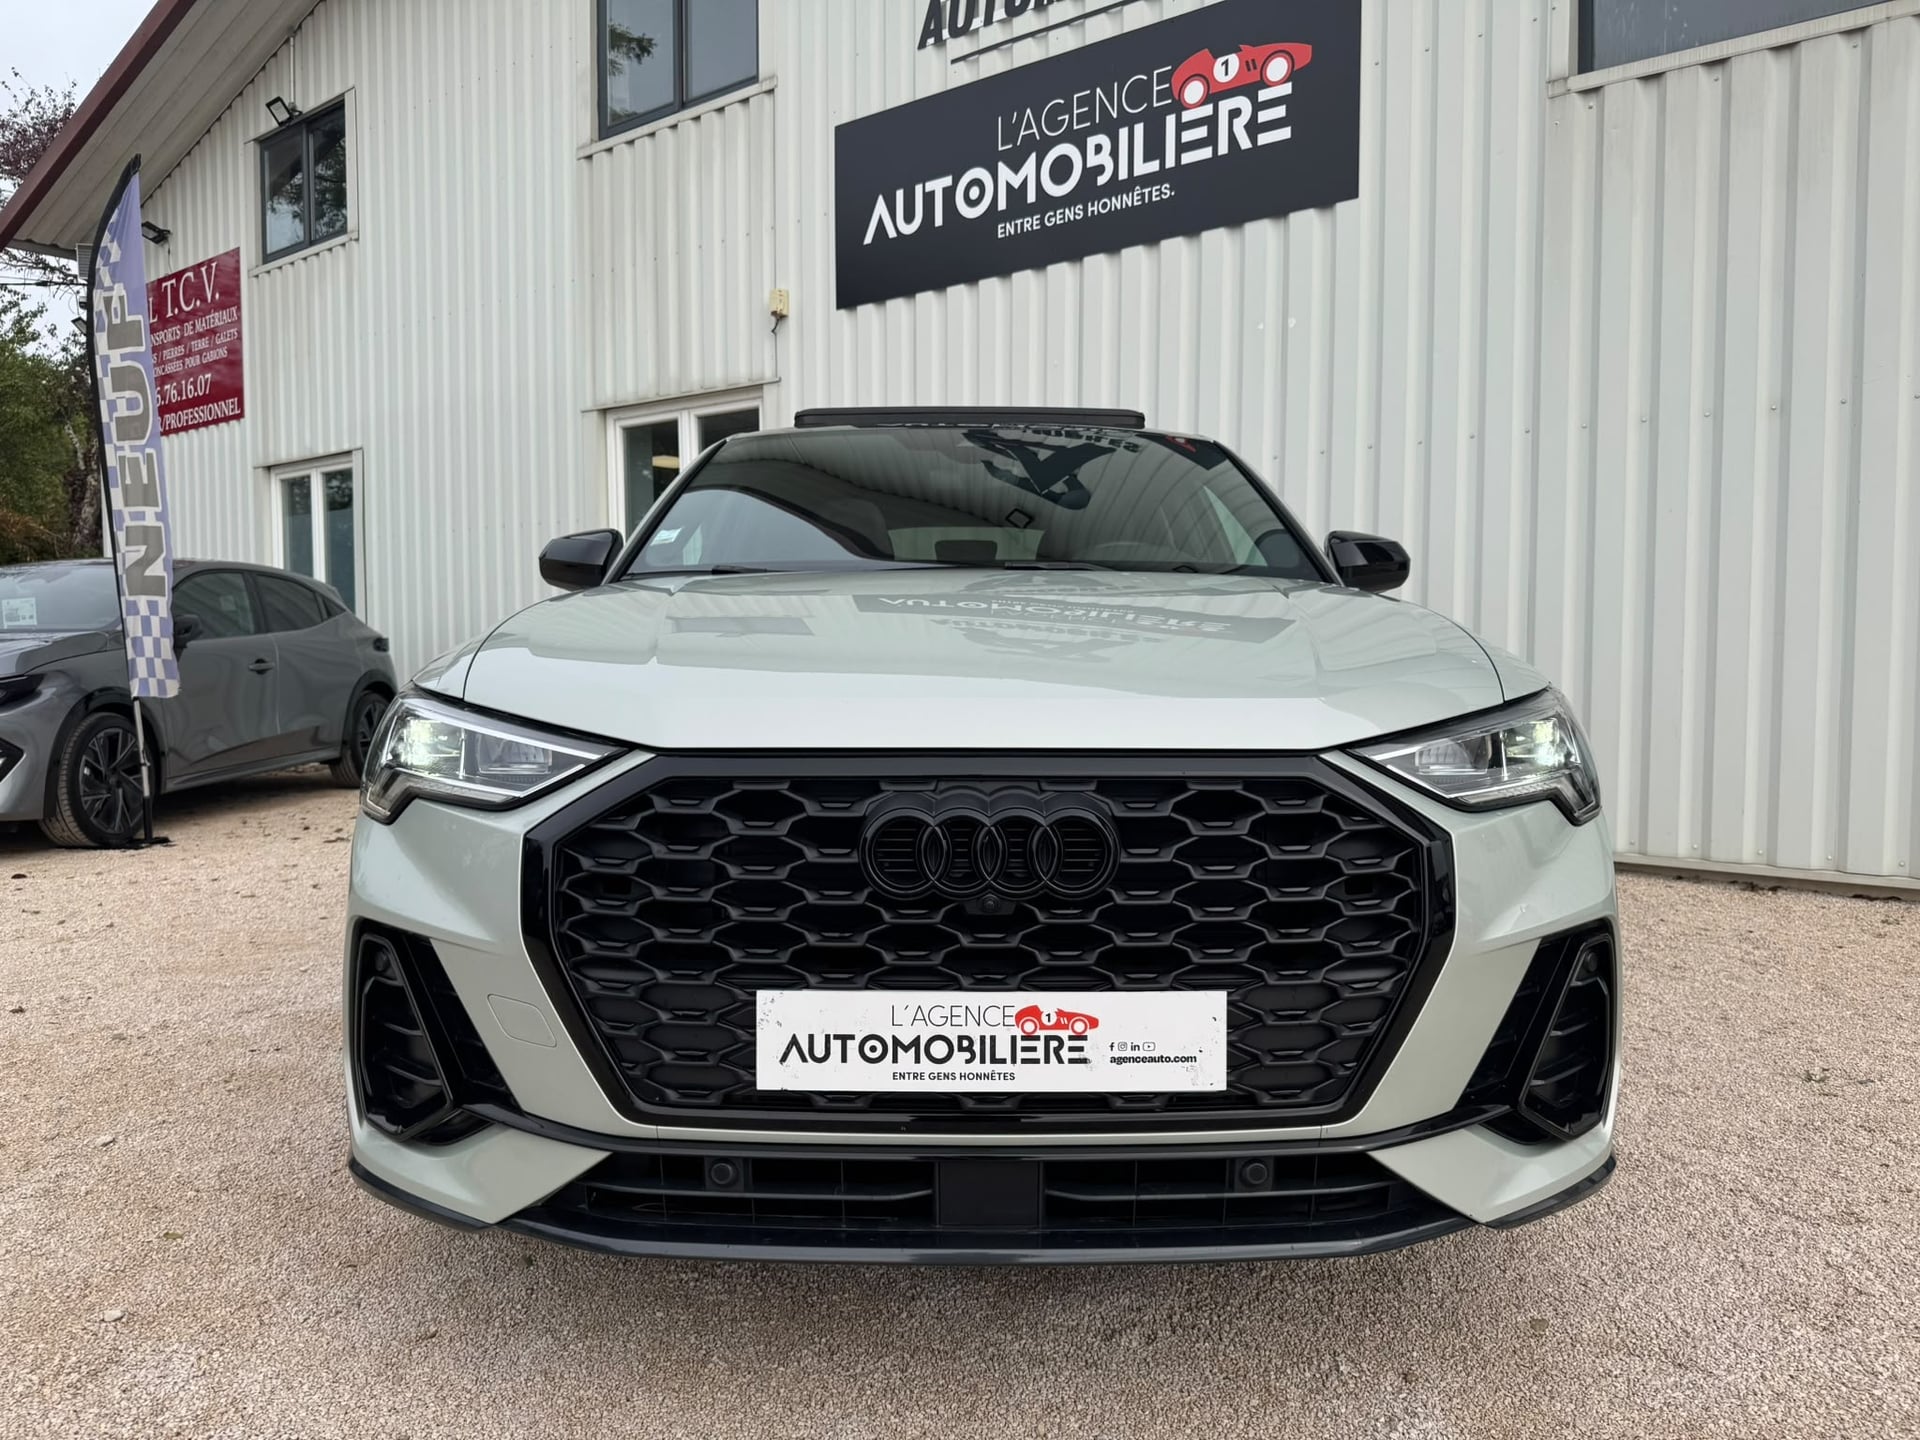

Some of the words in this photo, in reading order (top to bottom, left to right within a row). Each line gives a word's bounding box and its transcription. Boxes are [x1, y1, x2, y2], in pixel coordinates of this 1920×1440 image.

[998, 65, 1172, 151] L'AGENCE
[998, 214, 1041, 238] ENTRE
[1044, 204, 1084, 227] GENS
[1088, 183, 1176, 217] HONNÊTES.
[162, 261, 220, 318] T.C.V.
[183, 320, 194, 337] DE
[215, 328, 238, 345] GALETS
[201, 346, 228, 364] GABIONS
[98, 285, 167, 599] NEUF
[892, 1004, 1015, 1027] L'AGENCE
[1109, 1054, 1197, 1066] agenceauto.com
[892, 1071, 926, 1081] ENTRE
[928, 1071, 957, 1081] GENS
[959, 1069, 1016, 1081] HONNÊTES
